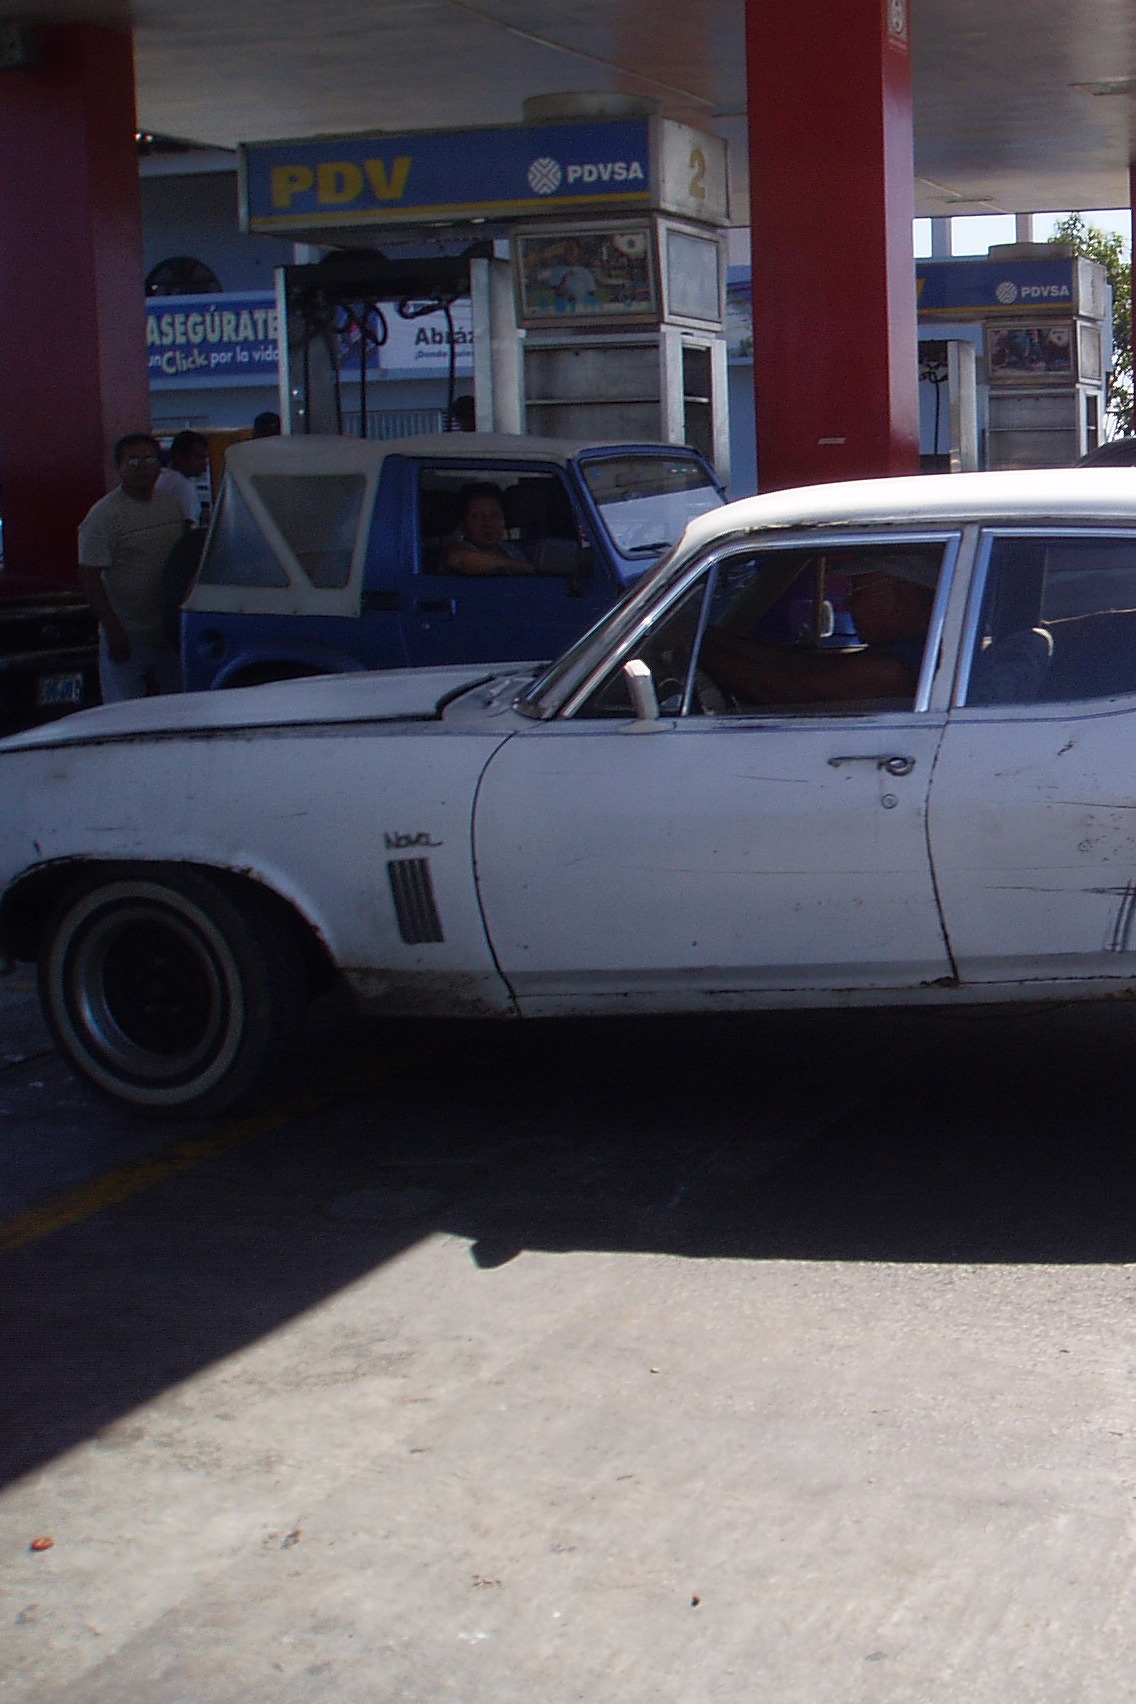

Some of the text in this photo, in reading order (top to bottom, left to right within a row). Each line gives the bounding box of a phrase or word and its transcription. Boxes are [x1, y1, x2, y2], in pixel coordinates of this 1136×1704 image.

[271, 156, 413, 208] PDV
[567, 161, 644, 184] PDVSA
[689, 149, 706, 199] 2
[1021, 285, 1070, 298] PDVSA
[146, 304, 279, 346] ASEGÚRATE
[162, 347, 209, 374] Click
[211, 351, 234, 368] por
[236, 345, 250, 362] la
[383, 831, 443, 850] Nova
